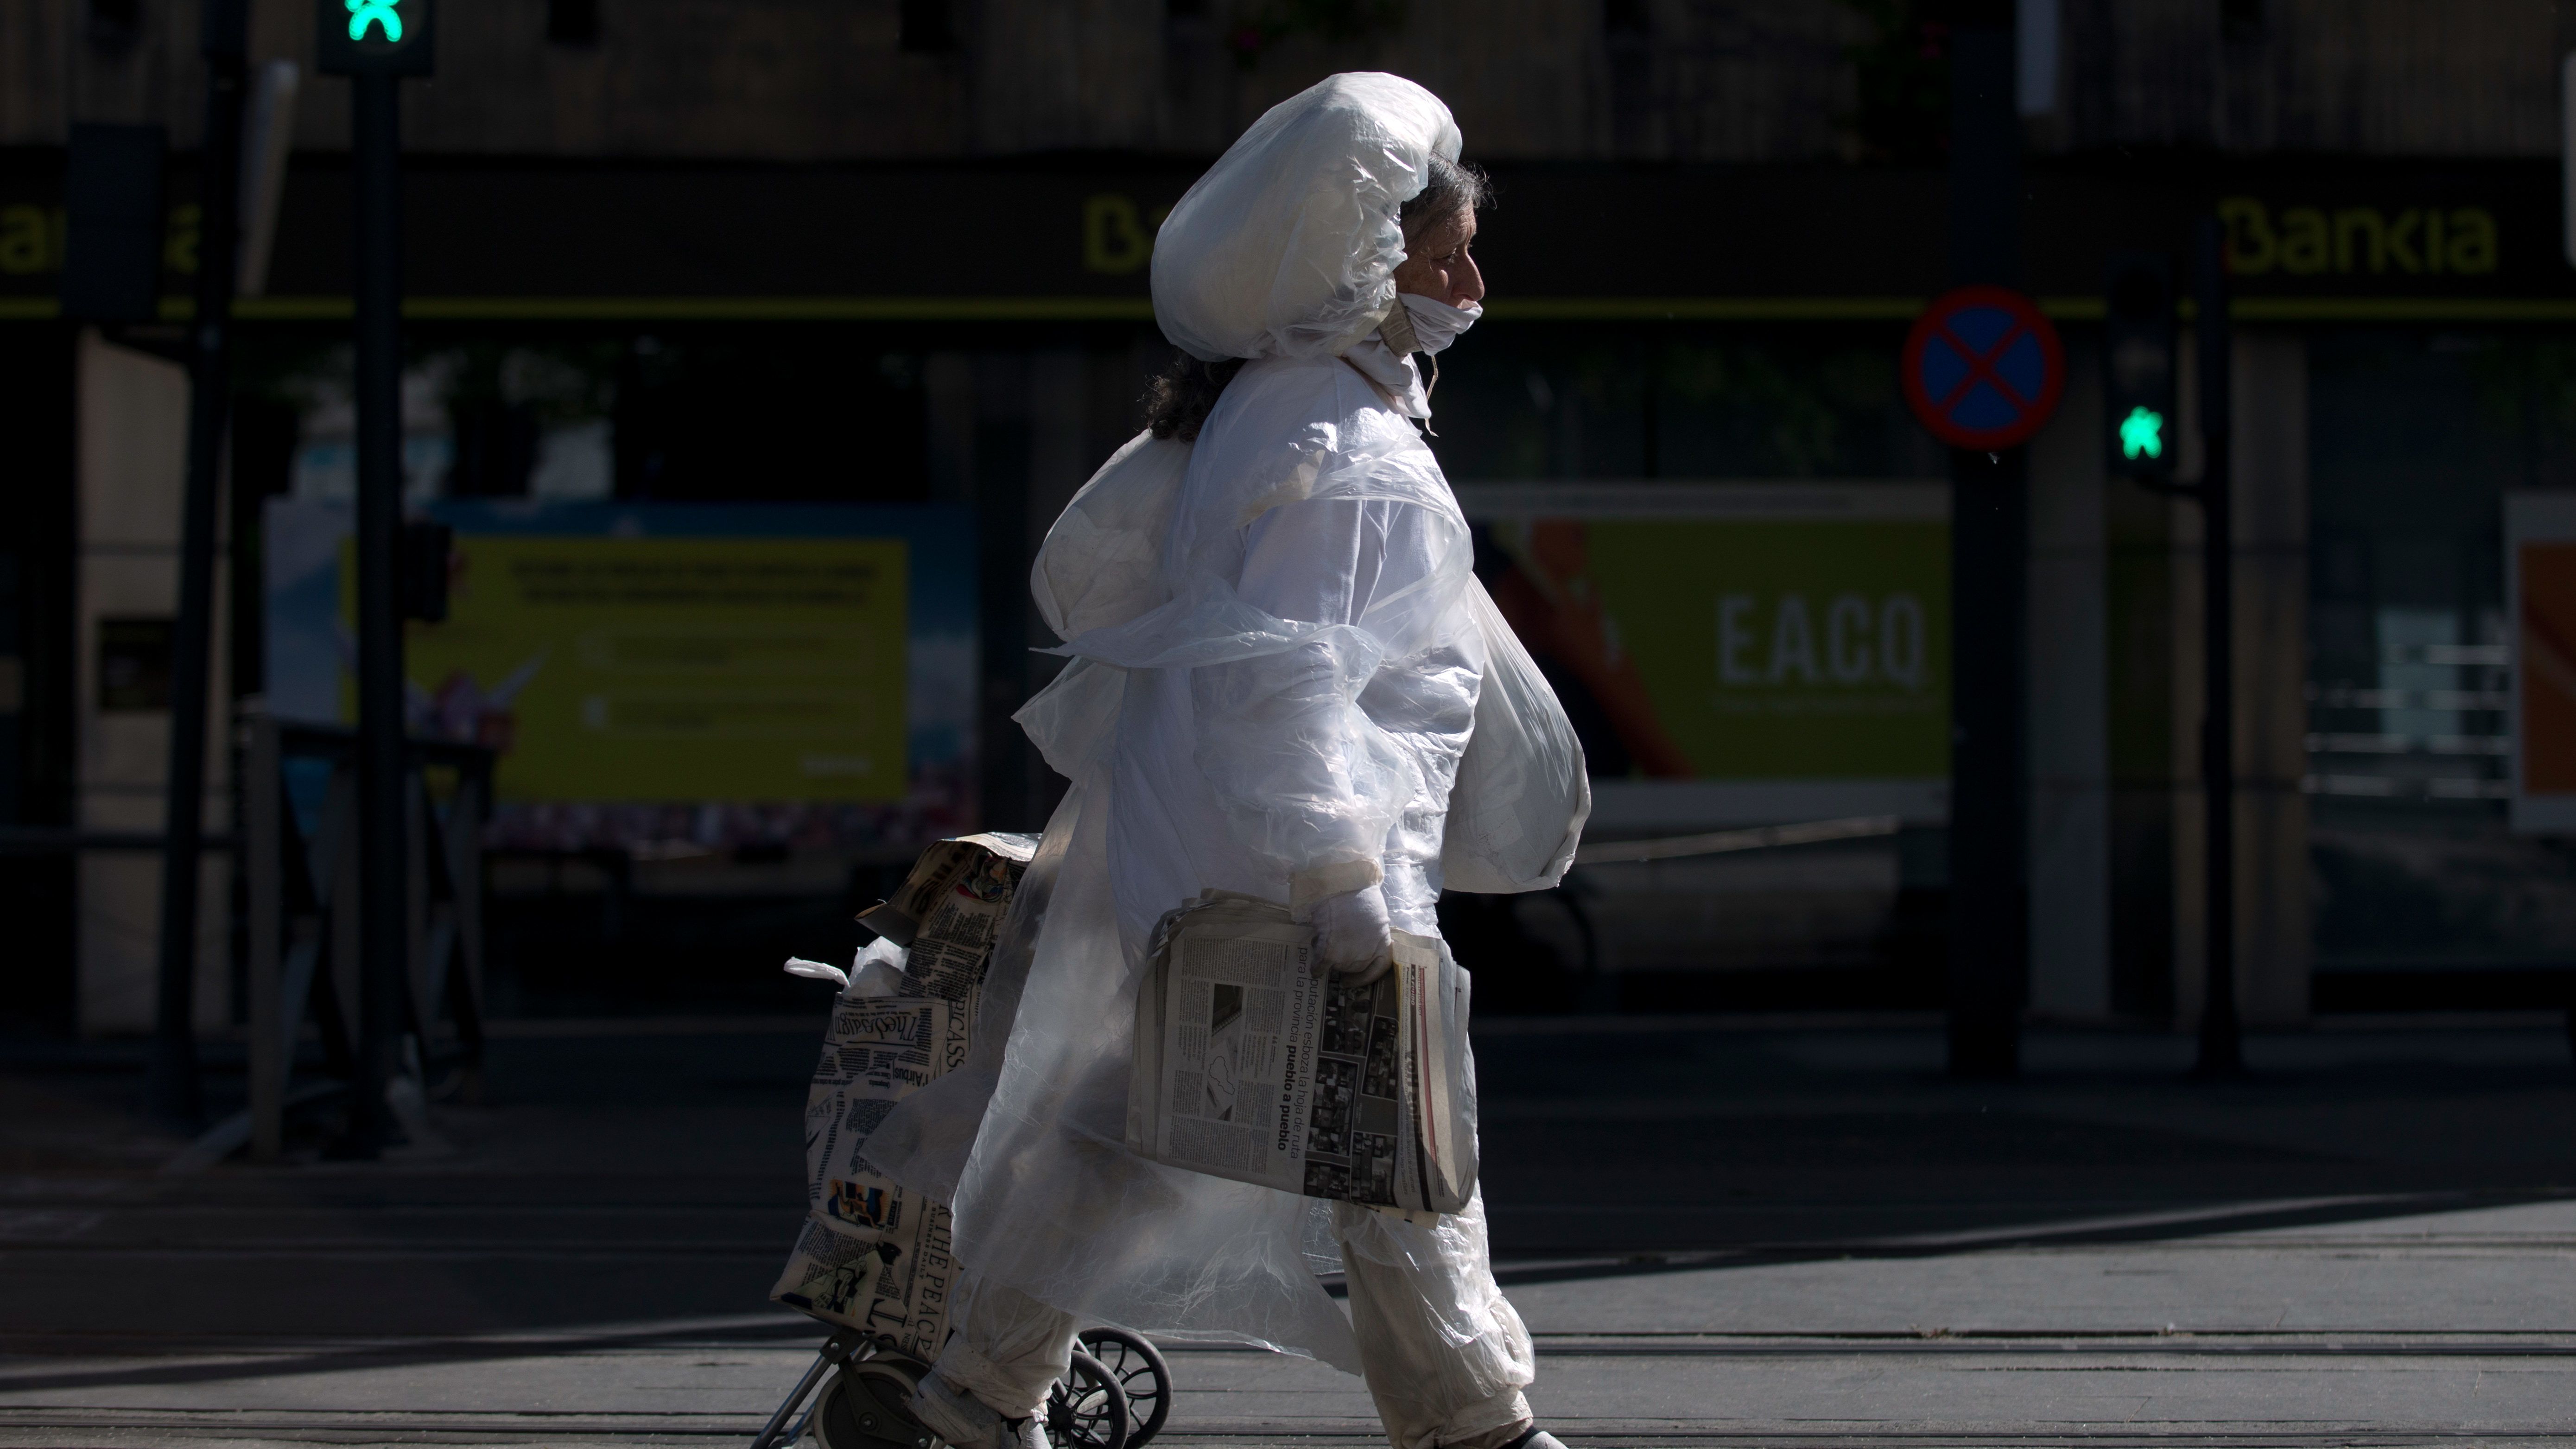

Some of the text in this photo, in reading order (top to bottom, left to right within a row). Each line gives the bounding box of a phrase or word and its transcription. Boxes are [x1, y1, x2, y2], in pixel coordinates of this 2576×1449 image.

[2214, 193, 2500, 277] Bankia
[946, 999, 966, 1073] PICASS
[1277, 947, 1308, 1151] para la provincia pueblo a pueblo
[1300, 1032, 1313, 1073] esboza
[1299, 1077, 1310, 1087] la
[1294, 1090, 1308, 1114] hoja
[1294, 1118, 1305, 1131] de
[1291, 1134, 1301, 1159] ruta
[919, 1251, 928, 1279] DAILY
